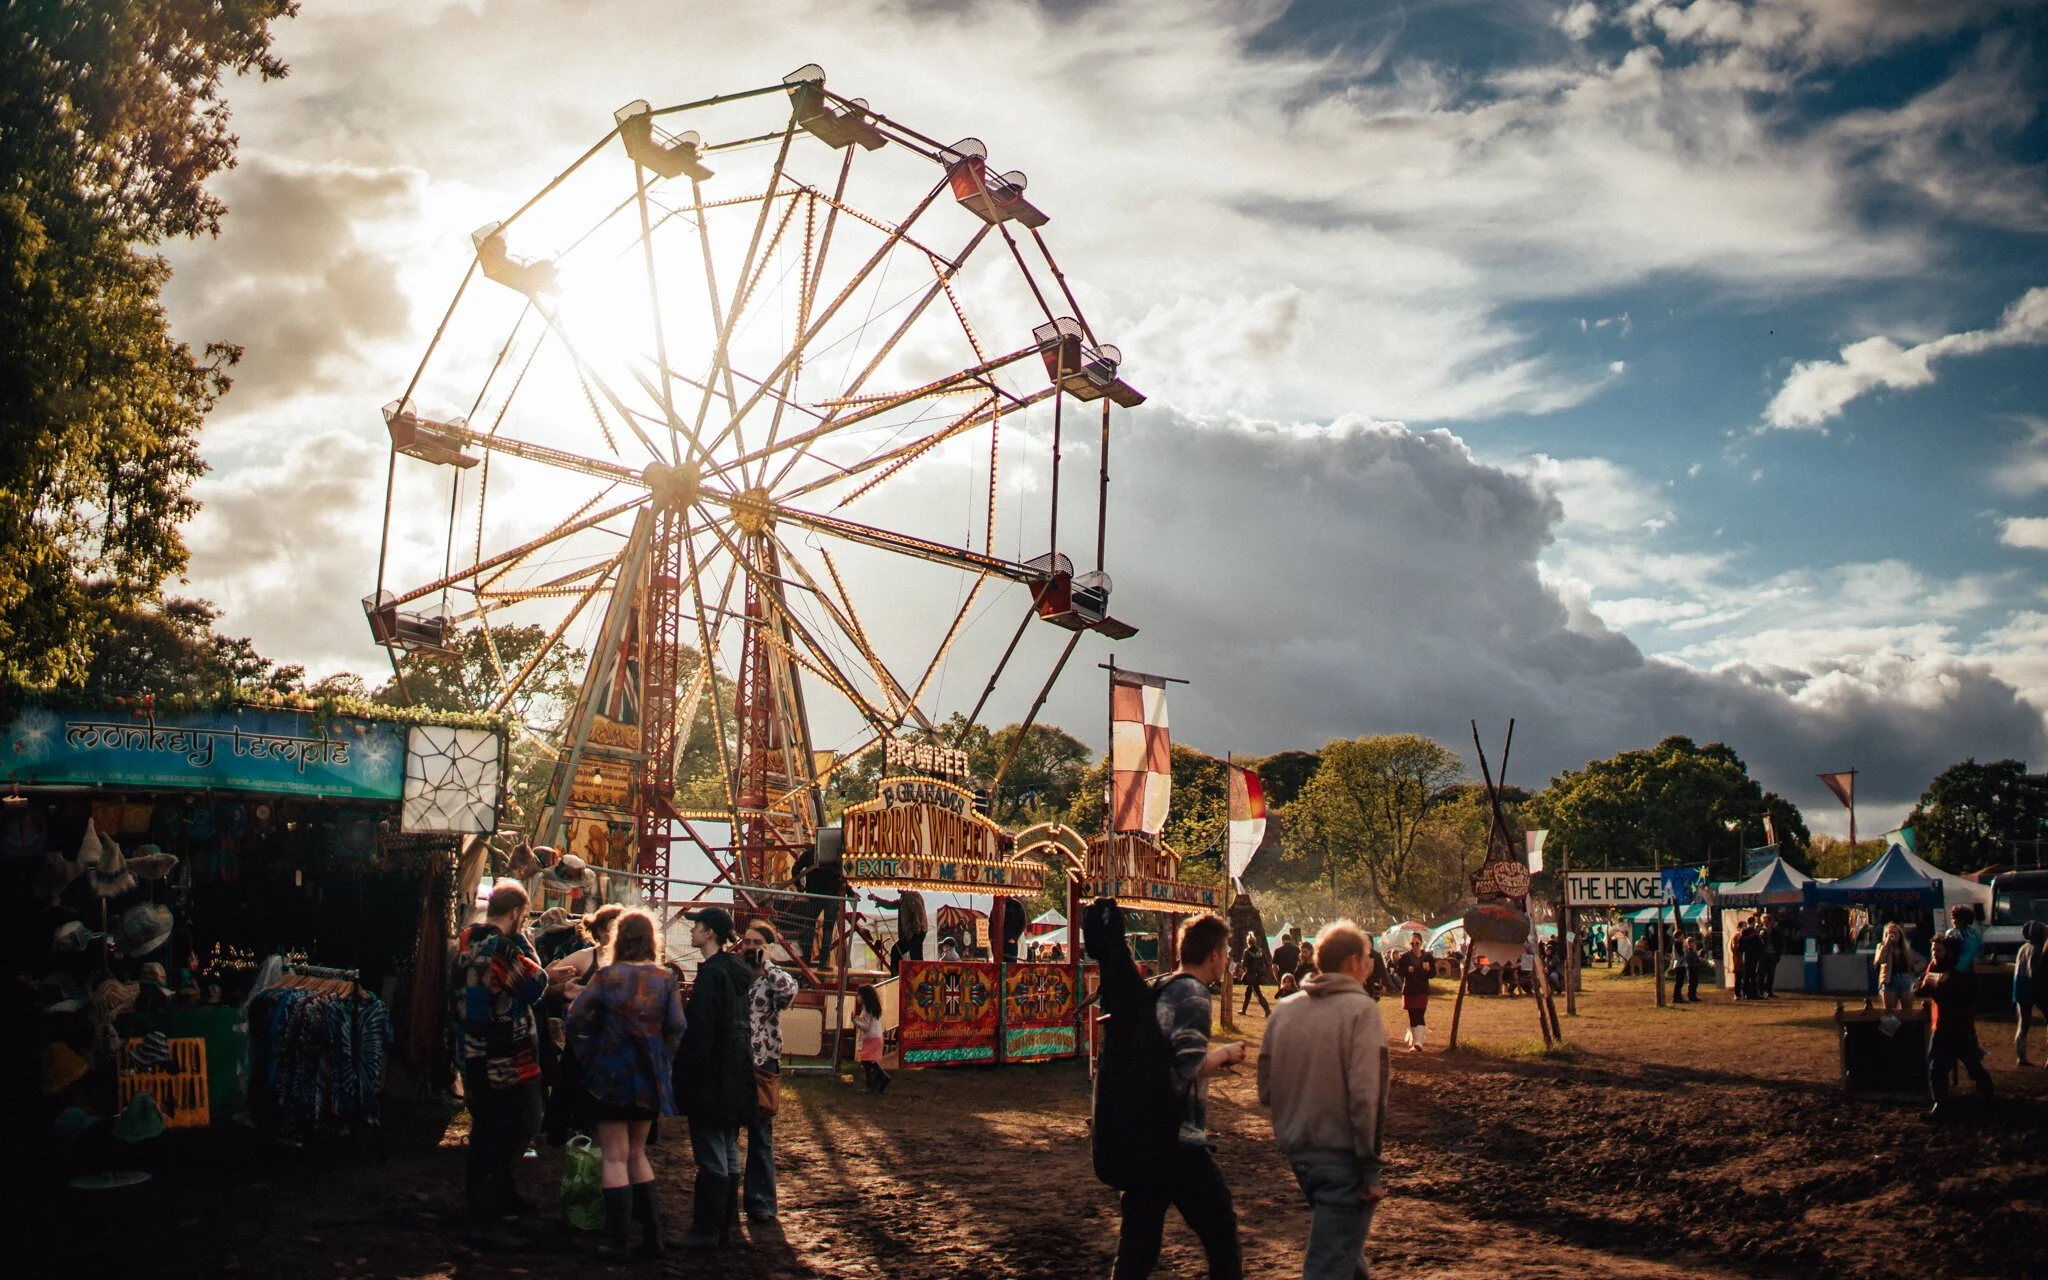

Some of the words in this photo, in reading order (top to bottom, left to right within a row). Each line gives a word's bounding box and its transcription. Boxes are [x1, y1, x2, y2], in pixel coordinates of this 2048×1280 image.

[65, 713, 215, 768] monkey
[233, 725, 351, 773] temple
[886, 738, 915, 767] BIG
[915, 743, 970, 777] WHEEL
[852, 804, 922, 854] FERRIS
[927, 804, 993, 860] WHEEL
[857, 860, 900, 877] EXIT
[913, 861, 932, 879] FLY
[940, 863, 956, 881] ME
[962, 864, 979, 881] TO
[984, 867, 1005, 884] THE
[1011, 869, 1044, 886] MOON
[1569, 877, 1601, 900] THE
[1605, 877, 1662, 900] HENGE
[1152, 884, 1174, 899] PLAY
[1202, 889, 1214, 904] THE
